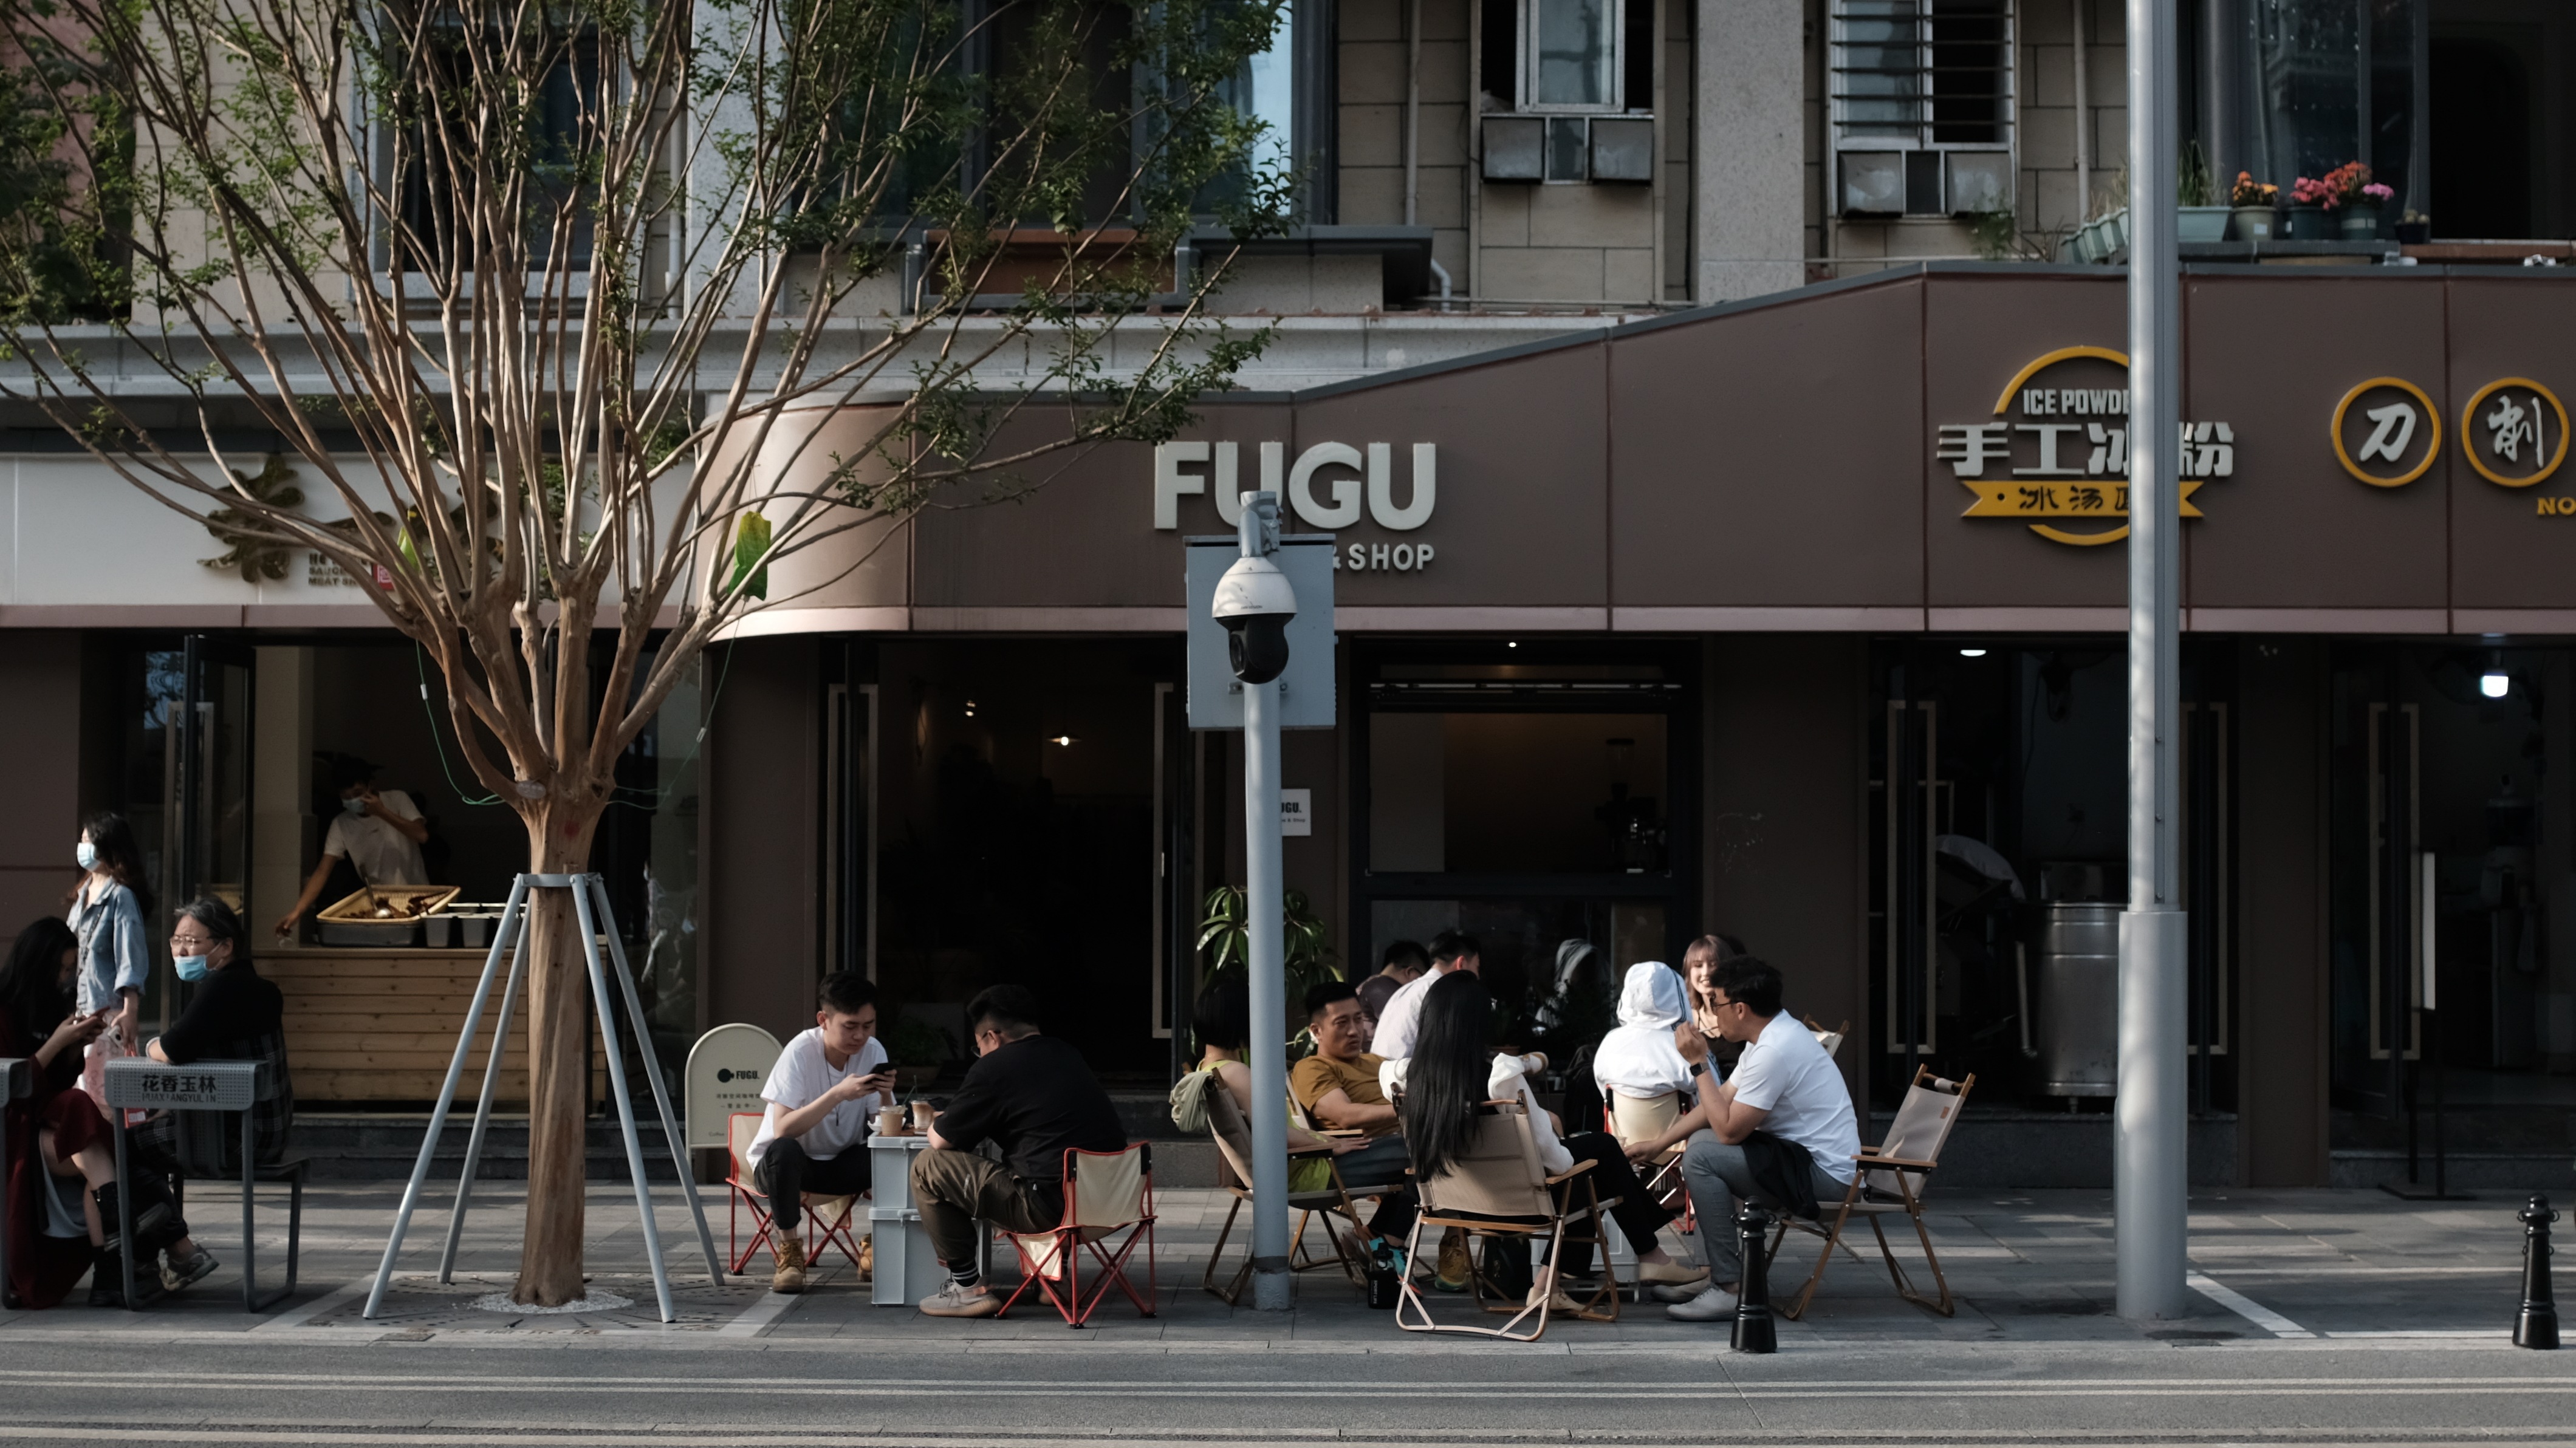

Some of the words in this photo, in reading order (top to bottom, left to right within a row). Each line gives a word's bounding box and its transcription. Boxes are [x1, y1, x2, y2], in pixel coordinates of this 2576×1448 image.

[2023, 389, 2057, 415] ICE
[1154, 441, 1436, 530] FUGU
[1348, 542, 1435, 571] SHOP
[142, 1074, 216, 1093] 花香玉林
[142, 1093, 216, 1103] HUAXIANGYULIN
